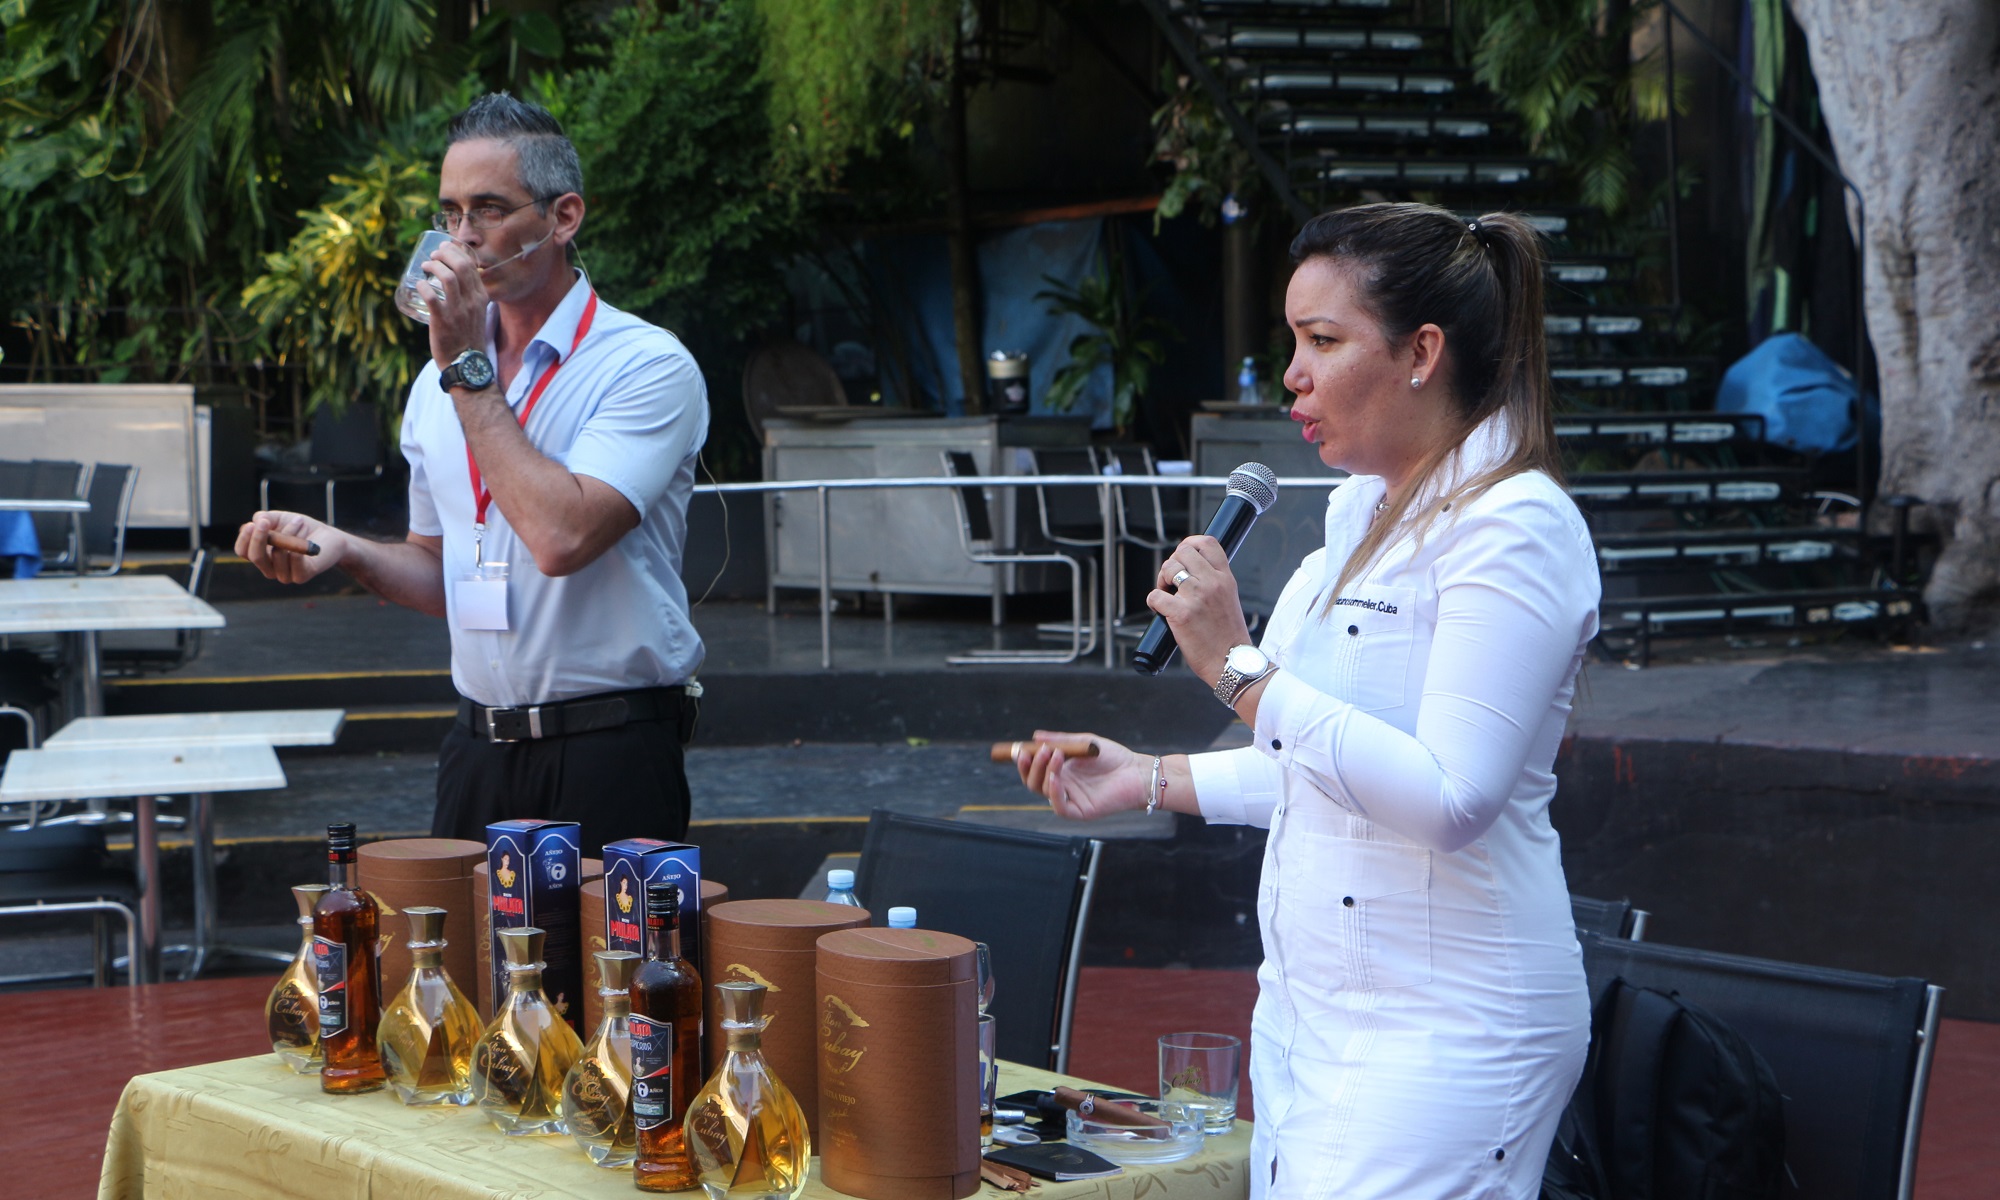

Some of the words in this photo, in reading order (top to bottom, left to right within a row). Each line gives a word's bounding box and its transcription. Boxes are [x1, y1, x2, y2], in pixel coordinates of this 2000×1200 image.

[493, 895, 524, 914] MULATA
[610, 920, 640, 942] MULATA
[274, 999, 313, 1025] Cubay
[822, 1010, 842, 1029] Ron
[489, 1041, 507, 1053] Ron
[480, 1053, 521, 1081] Cubay
[838, 1093, 856, 1106] VIEJO
[700, 1105, 718, 1119] Ron
[692, 1117, 729, 1150] Cubay
